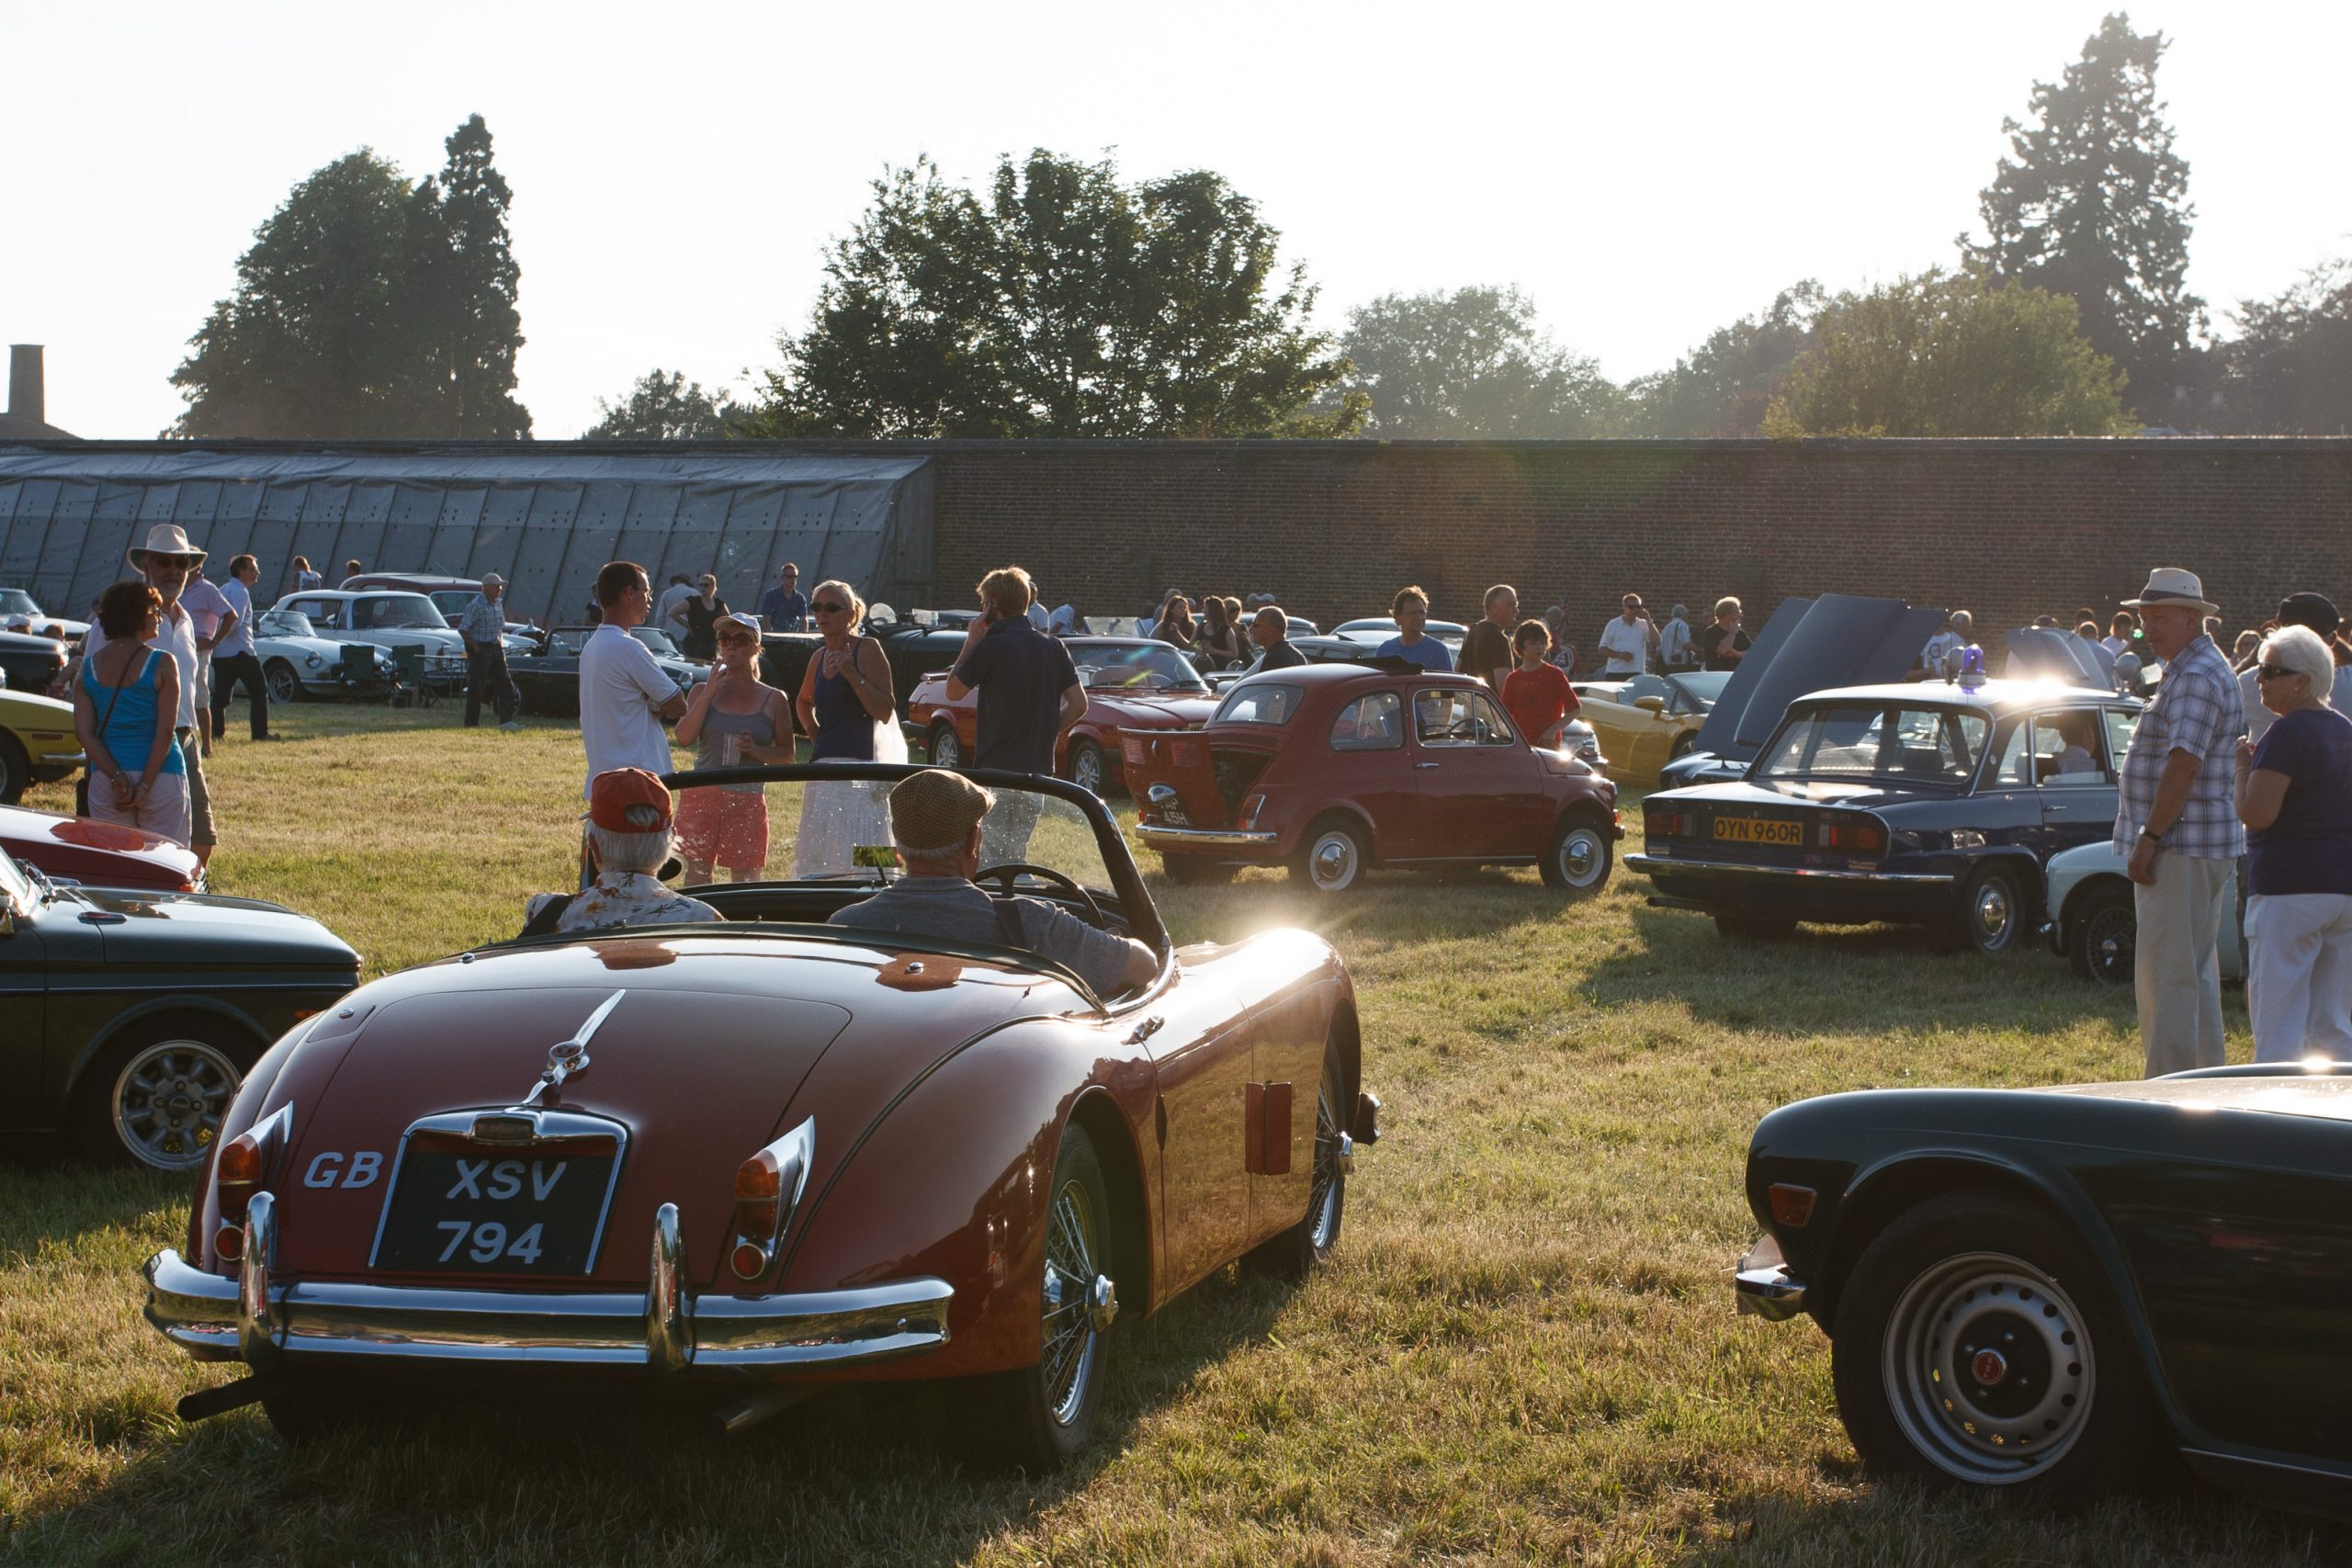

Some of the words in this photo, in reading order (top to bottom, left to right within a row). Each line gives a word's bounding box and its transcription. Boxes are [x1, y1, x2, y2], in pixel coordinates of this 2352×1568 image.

[1164, 810, 1189, 826] 45H
[1715, 819, 1749, 838] OYN
[1754, 823, 1801, 842] 960R
[303, 1151, 384, 1189] GB
[446, 1159, 568, 1201] XSV
[436, 1221, 544, 1265] 794
